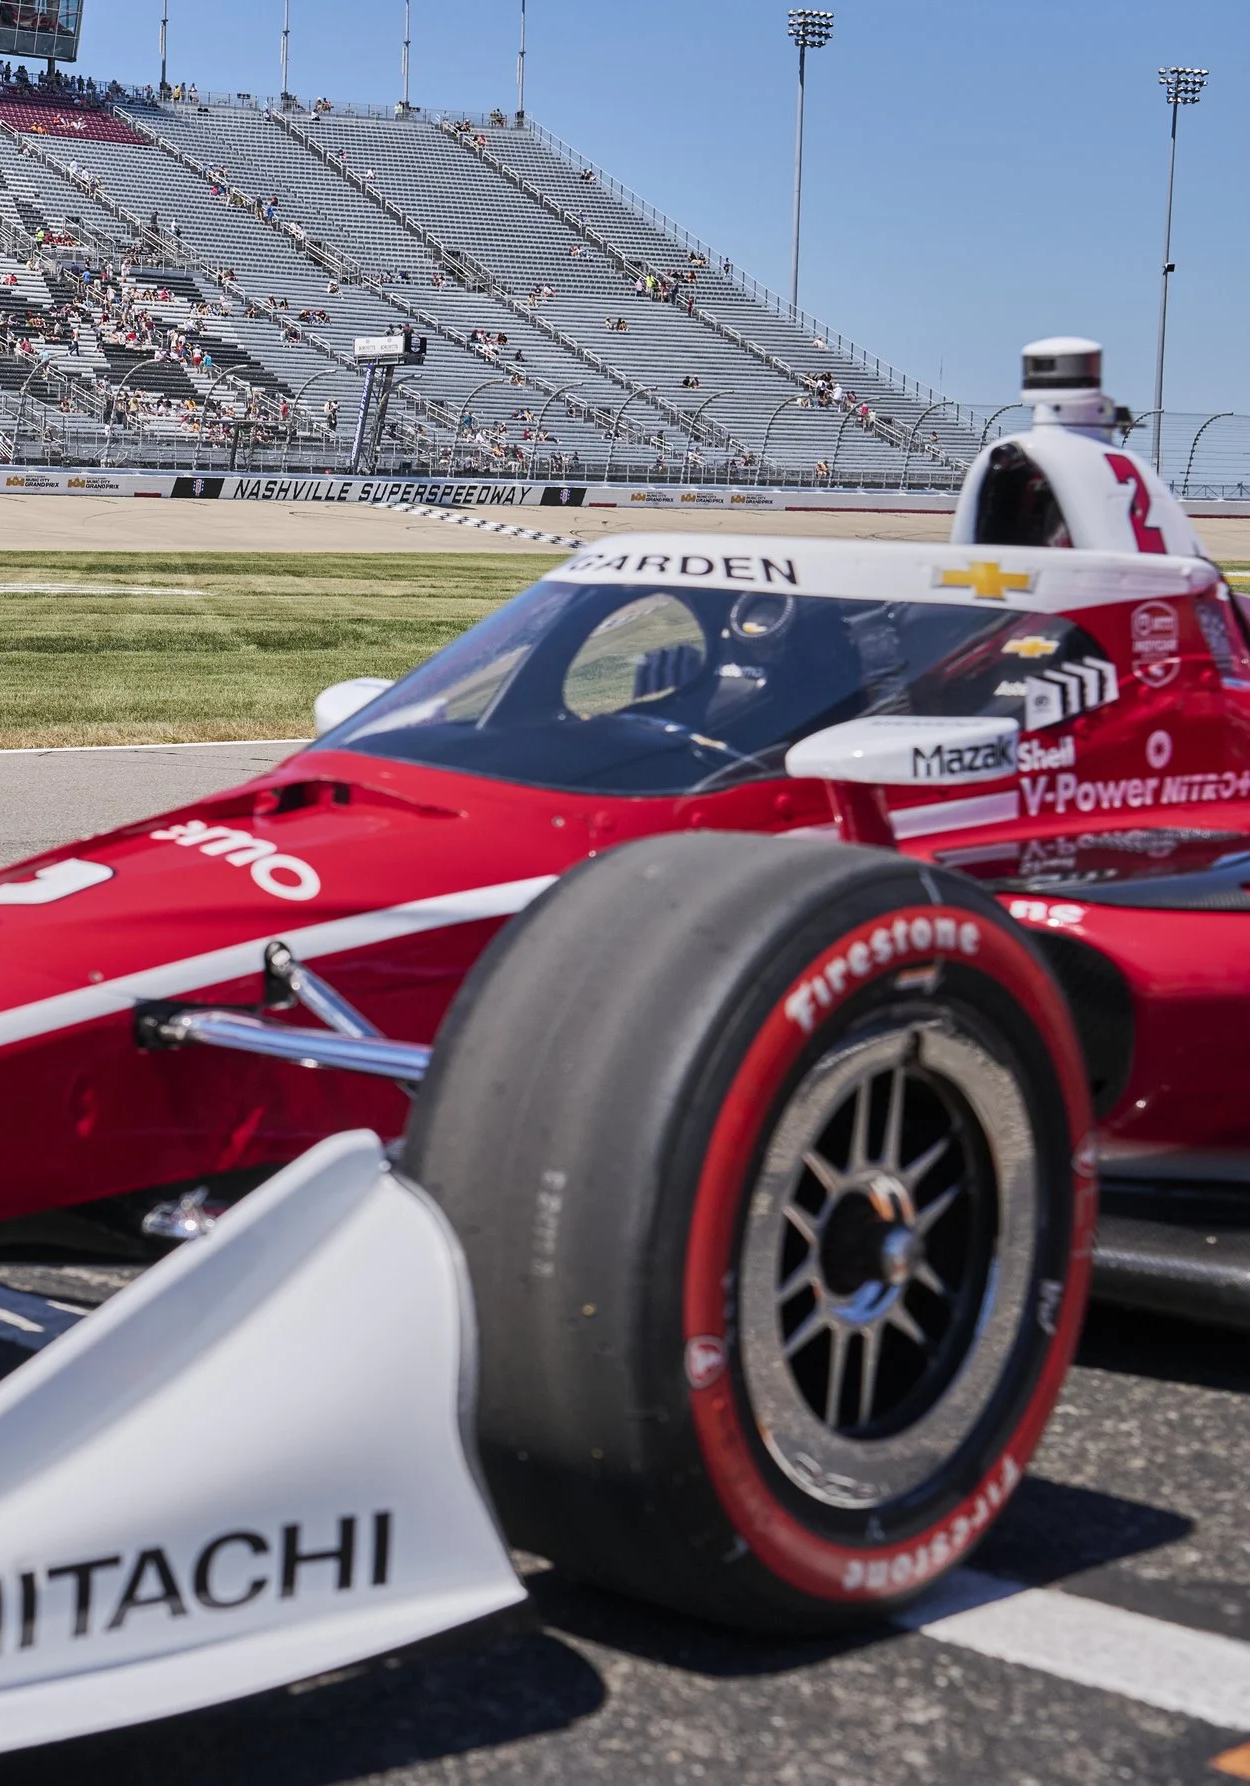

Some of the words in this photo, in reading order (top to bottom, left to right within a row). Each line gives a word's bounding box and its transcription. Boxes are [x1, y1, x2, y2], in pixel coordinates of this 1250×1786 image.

[233, 479, 353, 501] NASHVILLE
[358, 483, 533, 505] SUPERSPEEDWAY
[1103, 453, 1168, 554] 2
[912, 735, 1013, 779] Mazak
[1017, 735, 1076, 772] Shell
[1019, 772, 1160, 817] V-Power
[784, 916, 980, 1034] Firestone
[841, 1454, 1020, 1591] Firestone
